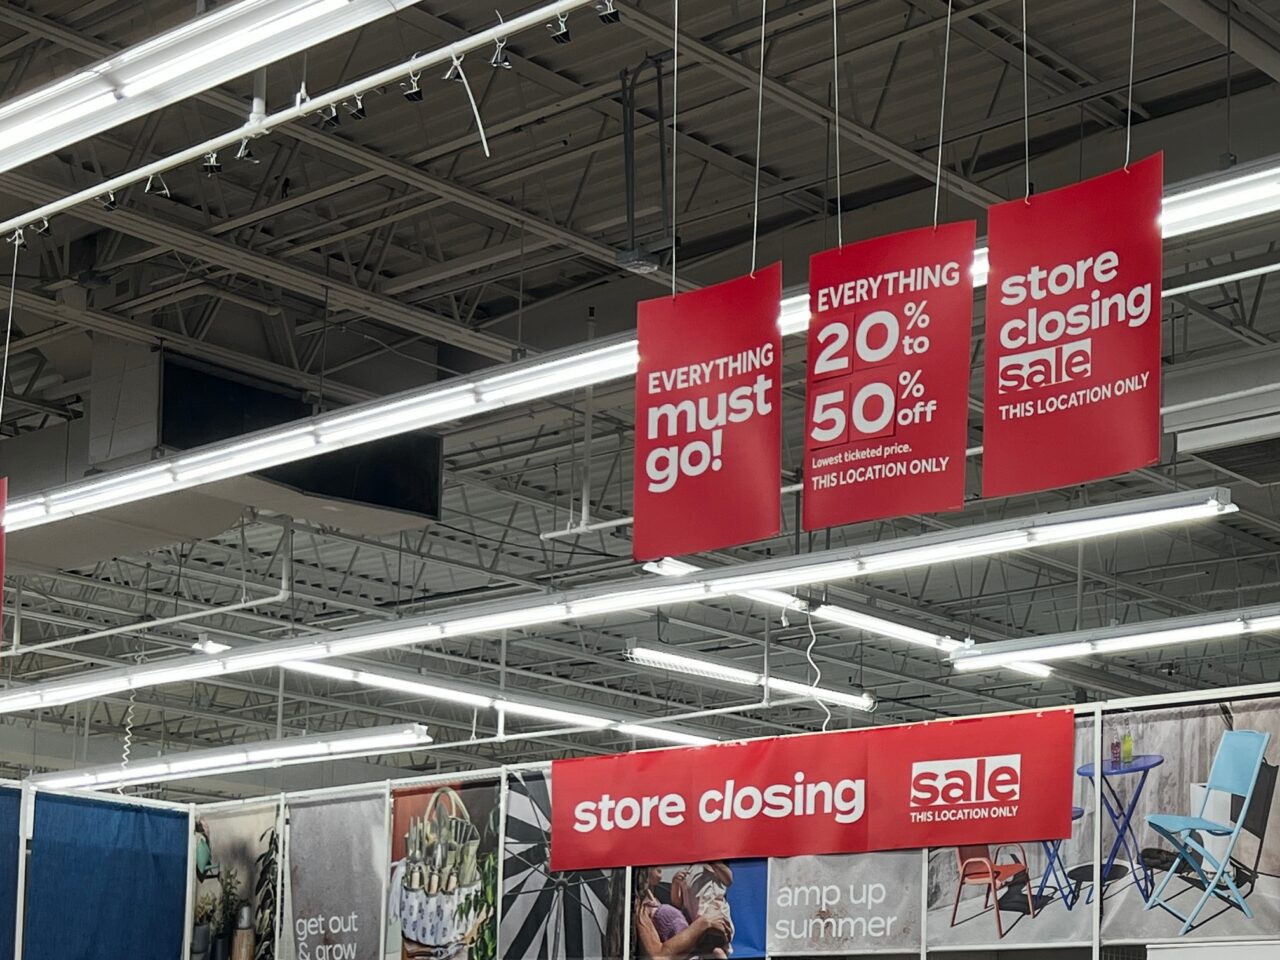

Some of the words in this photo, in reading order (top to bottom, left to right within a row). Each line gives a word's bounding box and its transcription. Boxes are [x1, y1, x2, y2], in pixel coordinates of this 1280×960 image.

[817, 261, 960, 313] EVERYTHING
[1001, 250, 1119, 305] store
[814, 301, 930, 375] 20%
[1000, 284, 1151, 349] closing
[648, 343, 774, 394] EVERYTHING
[902, 334, 930, 355] to
[999, 341, 1092, 393] sale
[647, 375, 772, 439] must
[810, 370, 924, 443] 50%
[898, 402, 937, 425] off
[999, 402, 1035, 421] THIS
[1037, 389, 1110, 416] LOCATION
[1114, 372, 1149, 397] ONLY
[645, 430, 723, 493] go!
[812, 451, 842, 468] Lowest
[845, 446, 882, 462] ticketed
[884, 443, 912, 458] price.
[812, 473, 838, 490] THIS
[840, 463, 907, 486] LOCATION
[909, 457, 949, 475] ONLY
[574, 793, 686, 833] store
[699, 771, 866, 823] closing
[911, 758, 1020, 807] sale
[910, 812, 933, 822] THIS
[934, 809, 988, 821] LOCATION
[990, 806, 1018, 818] ONLY
[296, 914, 324, 938] get
[329, 912, 358, 934] out
[776, 883, 841, 918] amp
[850, 881, 886, 913] up
[775, 914, 898, 939] summer
